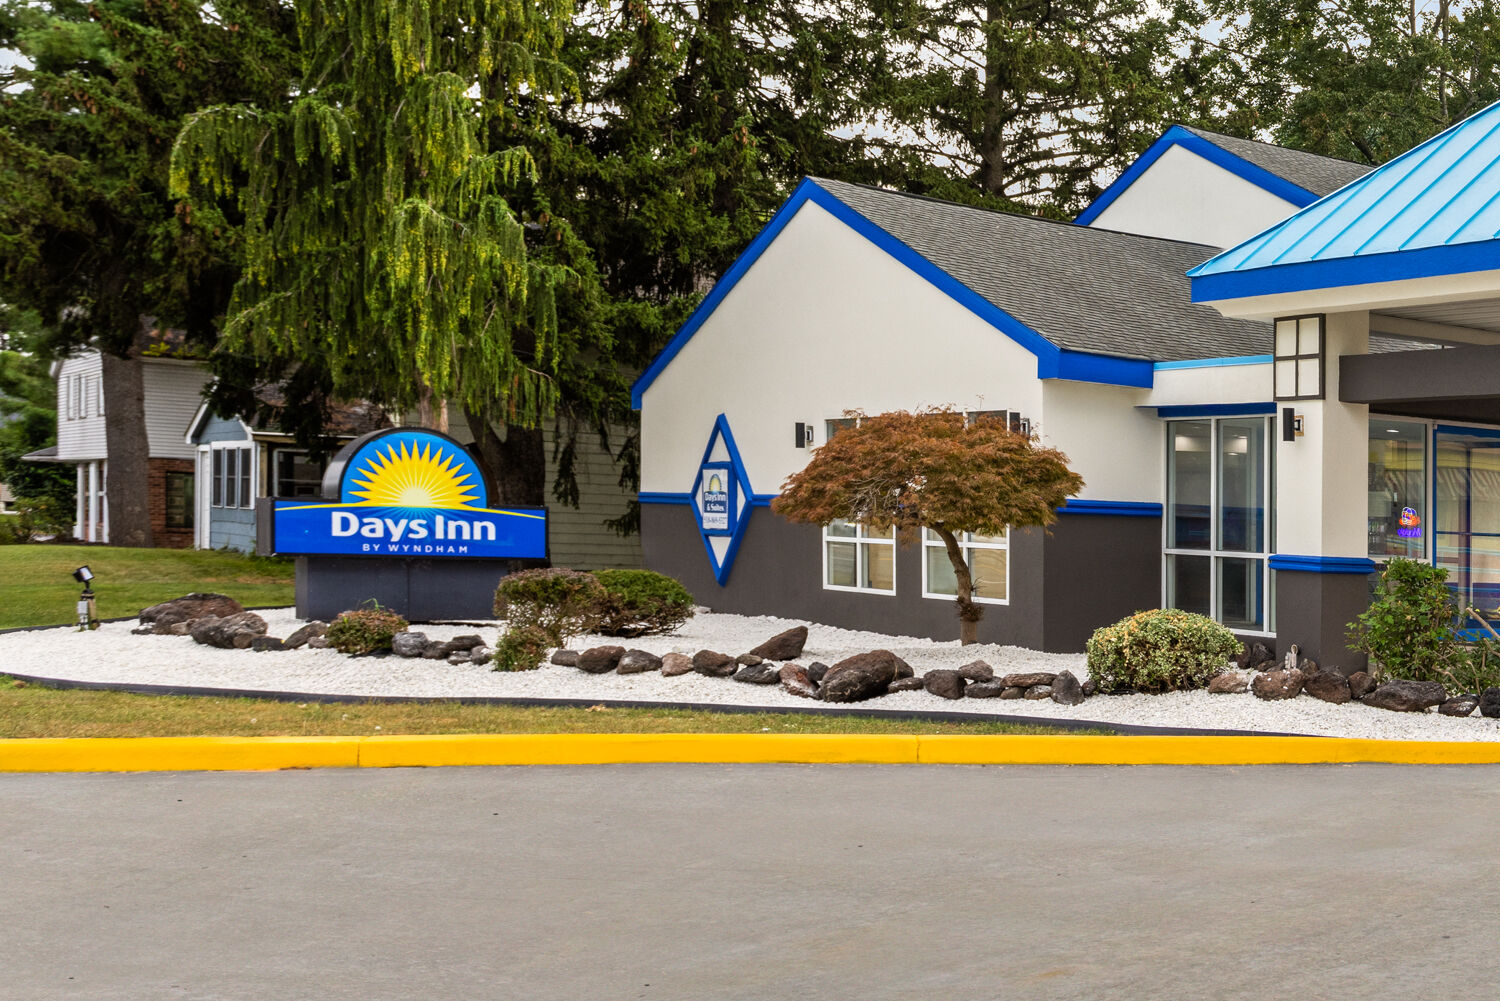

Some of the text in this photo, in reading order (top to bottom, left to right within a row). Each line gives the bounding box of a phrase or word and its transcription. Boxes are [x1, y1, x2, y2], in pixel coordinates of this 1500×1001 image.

[331, 511, 496, 542] Days Inn
[362, 543, 468, 553] BY WYNDHAM
